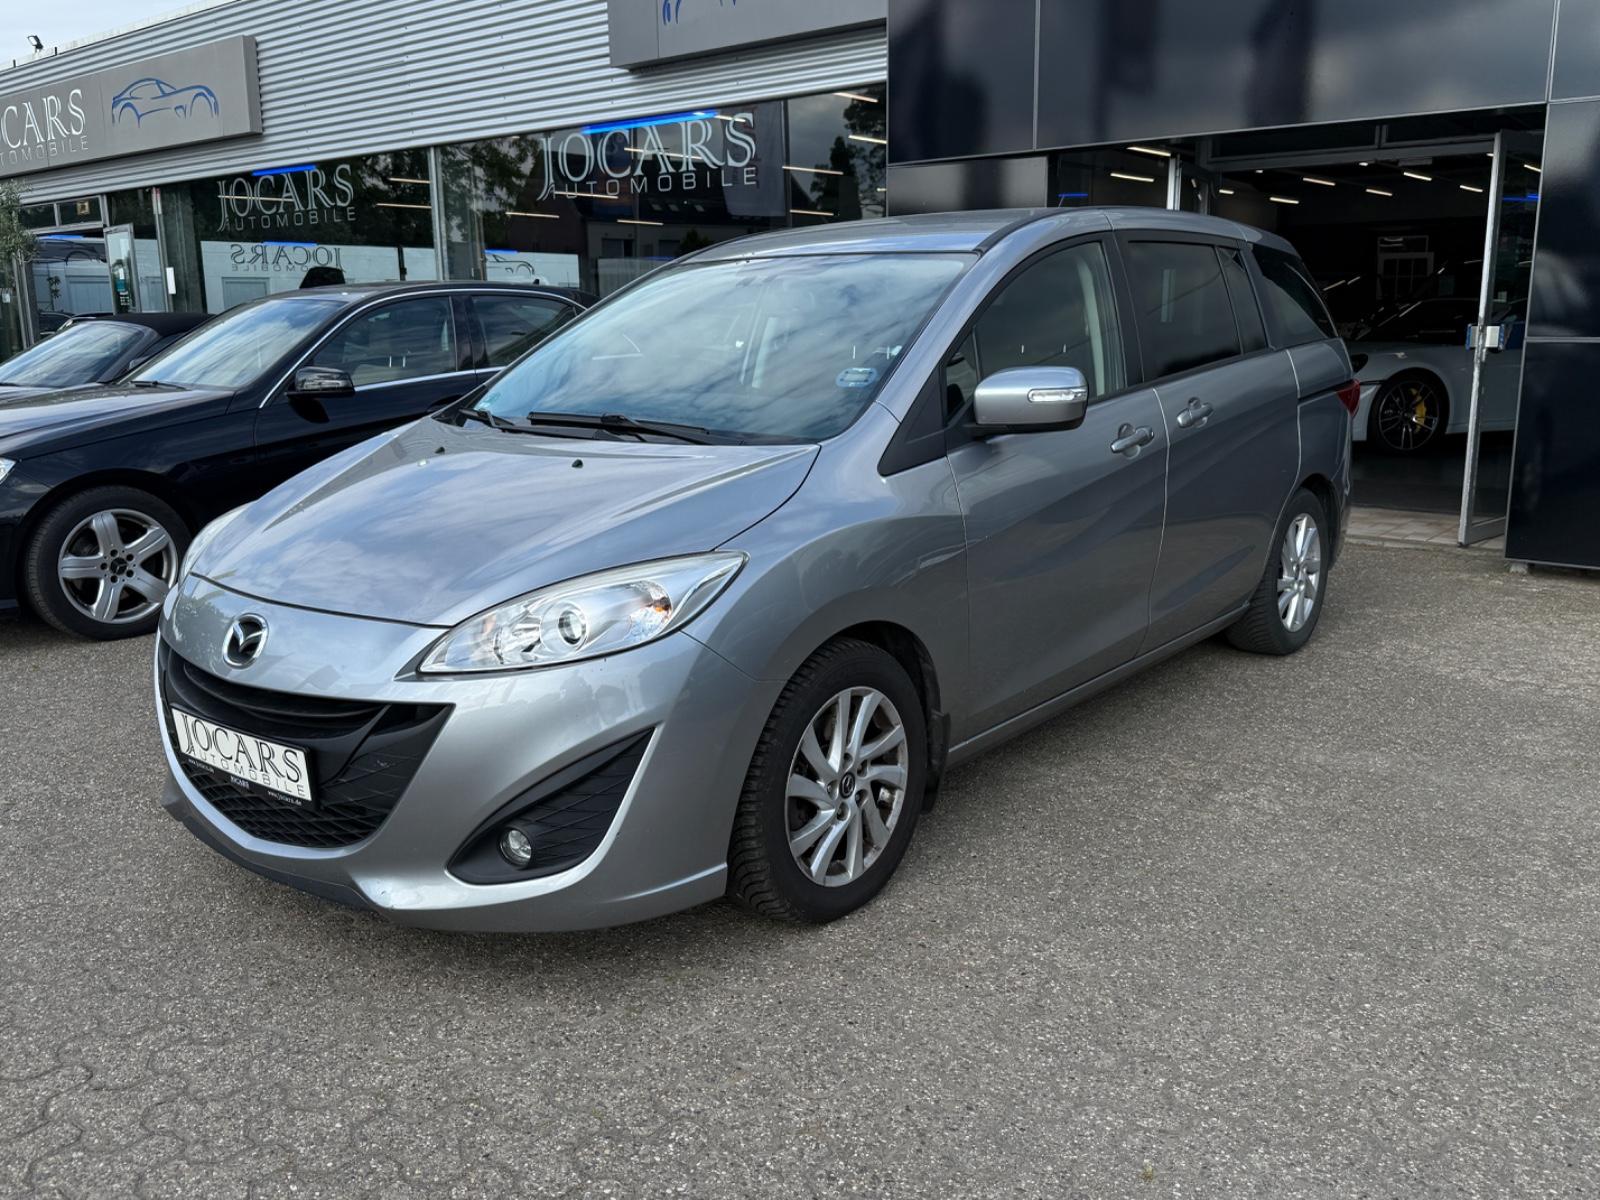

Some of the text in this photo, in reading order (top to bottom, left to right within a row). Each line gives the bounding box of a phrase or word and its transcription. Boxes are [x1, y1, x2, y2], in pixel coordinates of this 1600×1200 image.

[537, 112, 757, 201] JOCARS
[548, 167, 757, 200] AUTOMOBILE
[217, 164, 354, 232] JOCARS
[225, 207, 357, 232] AUTOMOBILE
[181, 714, 302, 783] JOCARS
[187, 746, 306, 796] AUTOMOBILE
